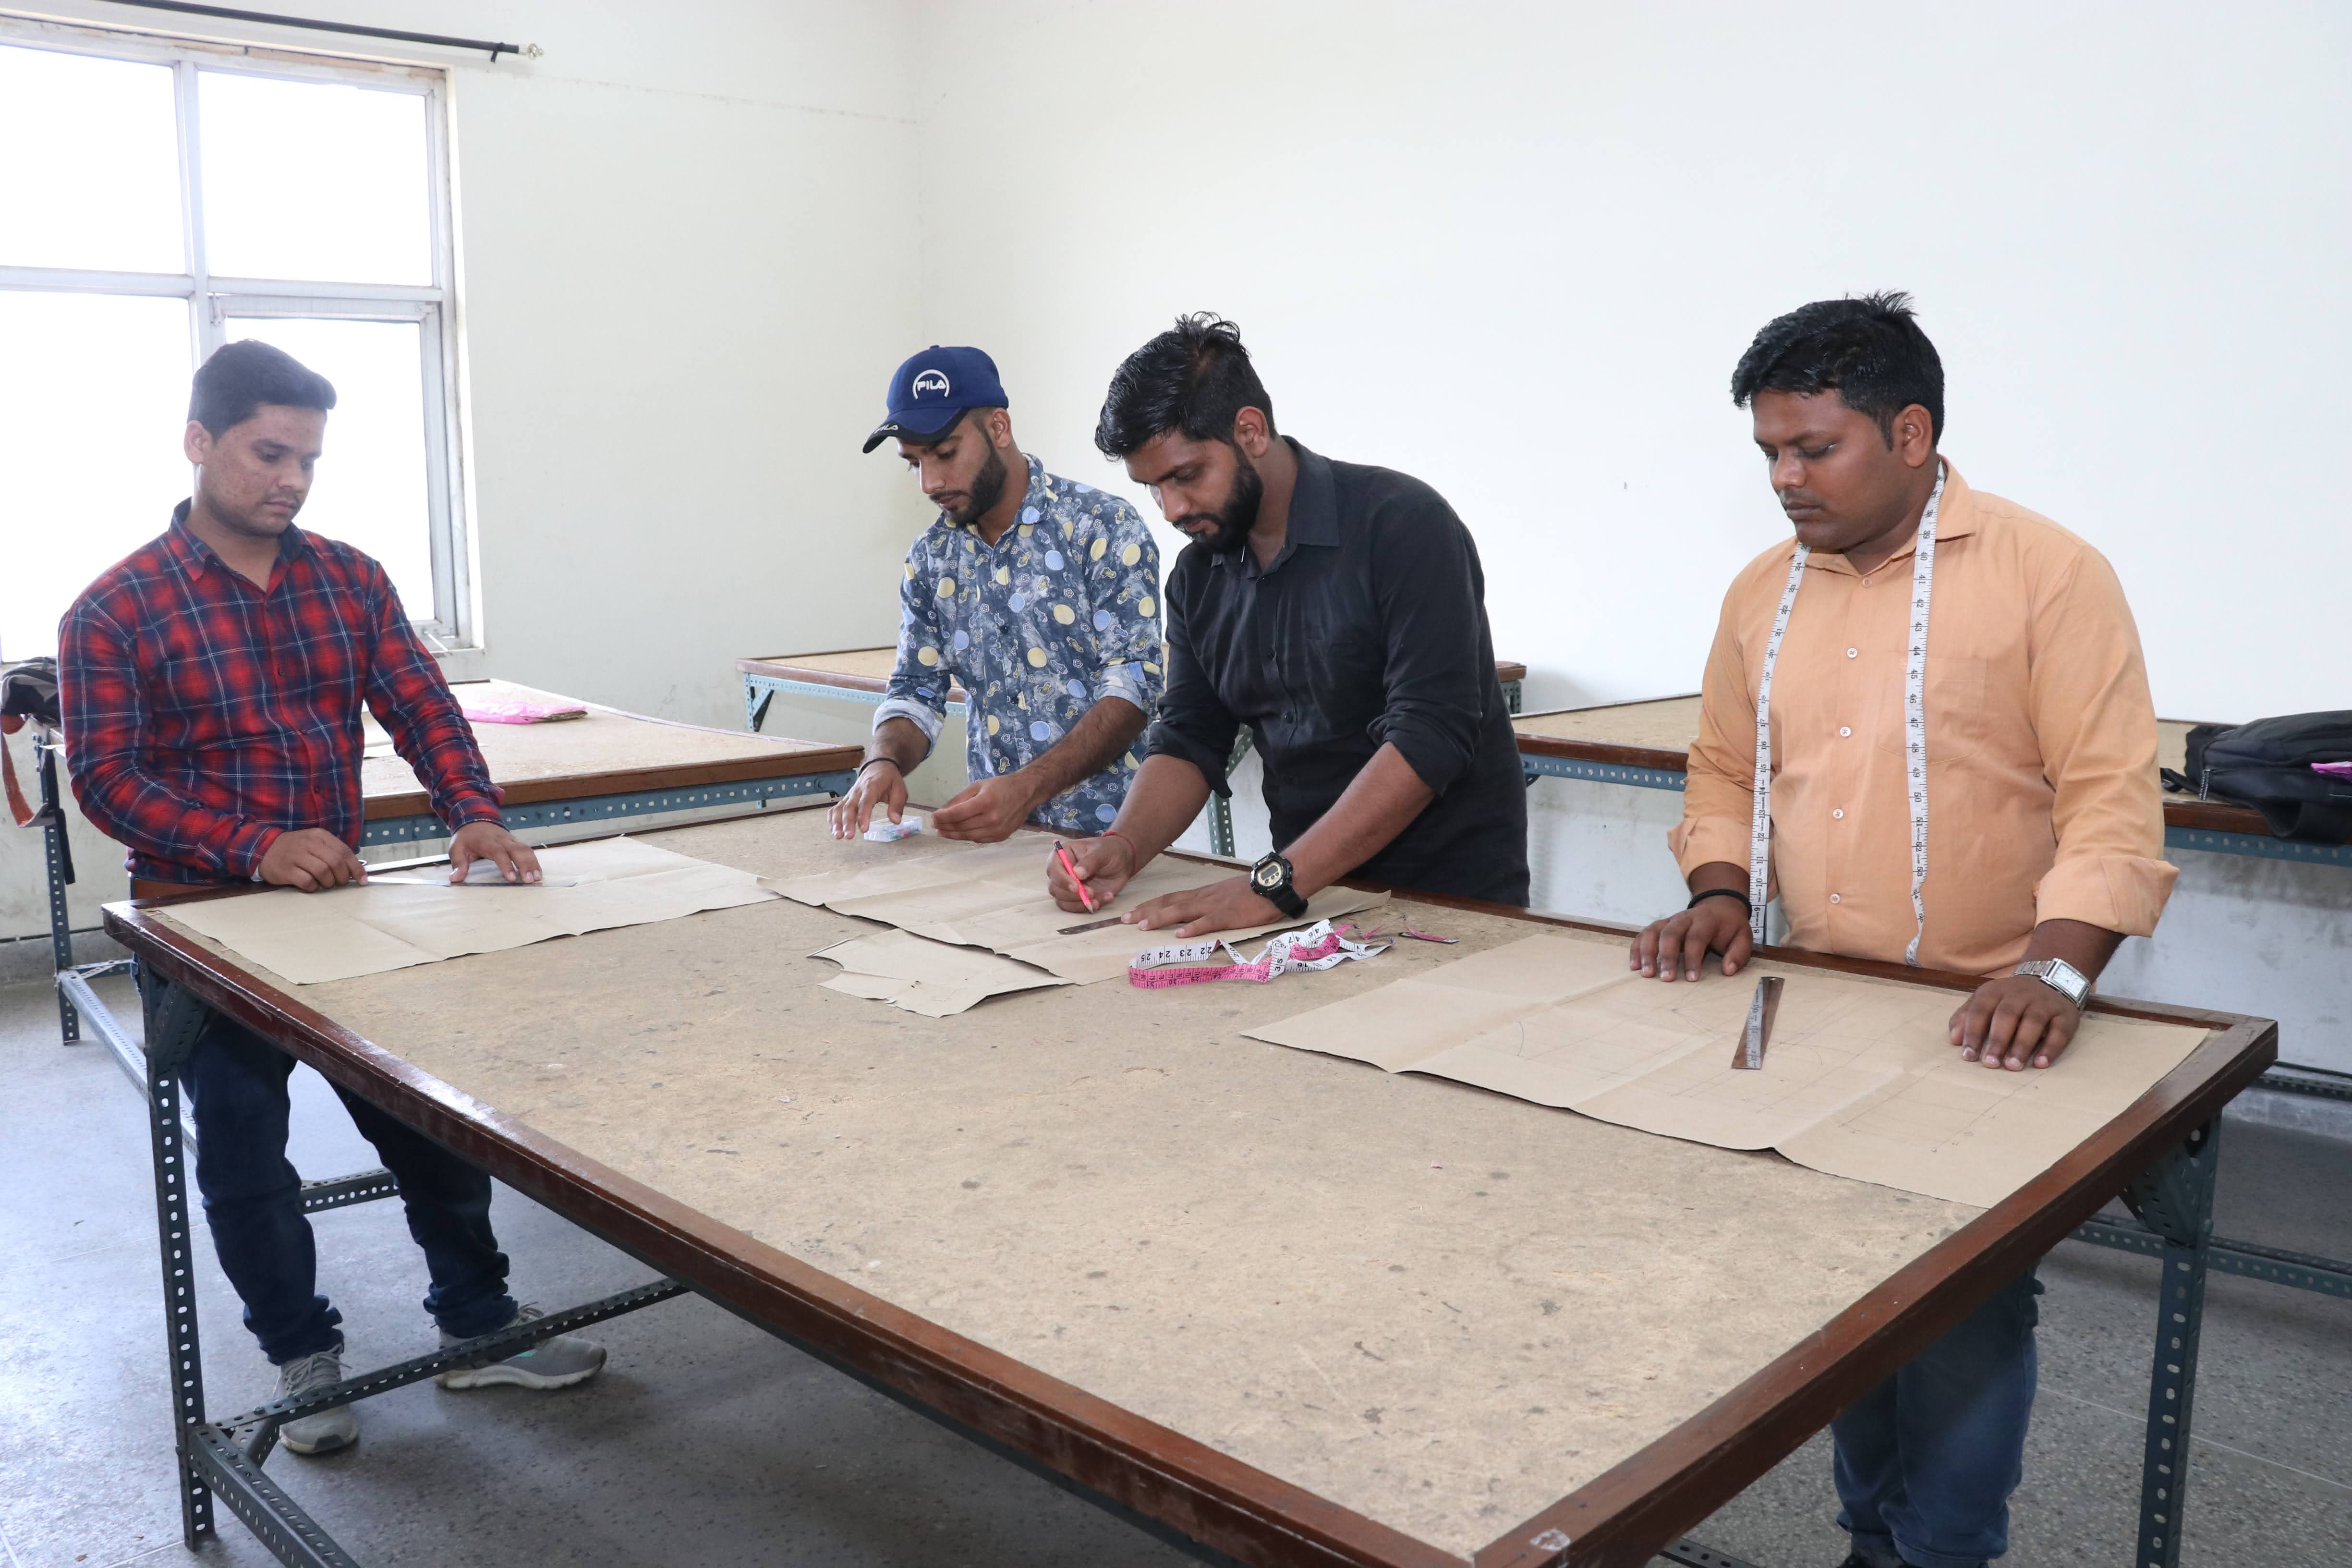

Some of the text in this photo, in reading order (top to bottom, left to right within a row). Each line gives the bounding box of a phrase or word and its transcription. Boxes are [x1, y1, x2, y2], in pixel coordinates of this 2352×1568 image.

[917, 379, 946, 391] FILA
[1923, 530, 1930, 539] 39
[1921, 551, 1928, 561] 40
[1795, 562, 1802, 571] 24
[1919, 574, 1926, 584] 41
[1788, 584, 1796, 593] 23
[1917, 598, 1924, 608] 42
[1781, 605, 1788, 615] 22
[1915, 622, 1922, 632] 43
[1775, 628, 1782, 637] 21
[1768, 649, 1775, 659] 20
[1914, 645, 1921, 656] 44
[1765, 672, 1770, 681] 19
[1911, 669, 1918, 679] 45
[1761, 695, 1766, 704] 18
[1909, 693, 1917, 703] 46
[1760, 718, 1766, 727] 17
[1911, 717, 1918, 728] 47
[1761, 741, 1767, 750] 16
[1912, 742, 1919, 753] 48
[1760, 764, 1766, 773] 15
[1913, 767, 1920, 778] 49
[1759, 787, 1765, 795] 14
[1914, 792, 1922, 802] 50
[1759, 810, 1765, 818] 13
[1916, 817, 1923, 826] 51
[1758, 833, 1764, 841] 12
[1916, 841, 1922, 852] 52
[1757, 856, 1763, 864] 11
[1917, 866, 1923, 876] 53
[1756, 878, 1763, 887] 10
[1309, 928, 1320, 937] 46
[1141, 953, 1151, 961] 25
[1229, 948, 1240, 958] 20
[1275, 959, 1283, 972] 35
